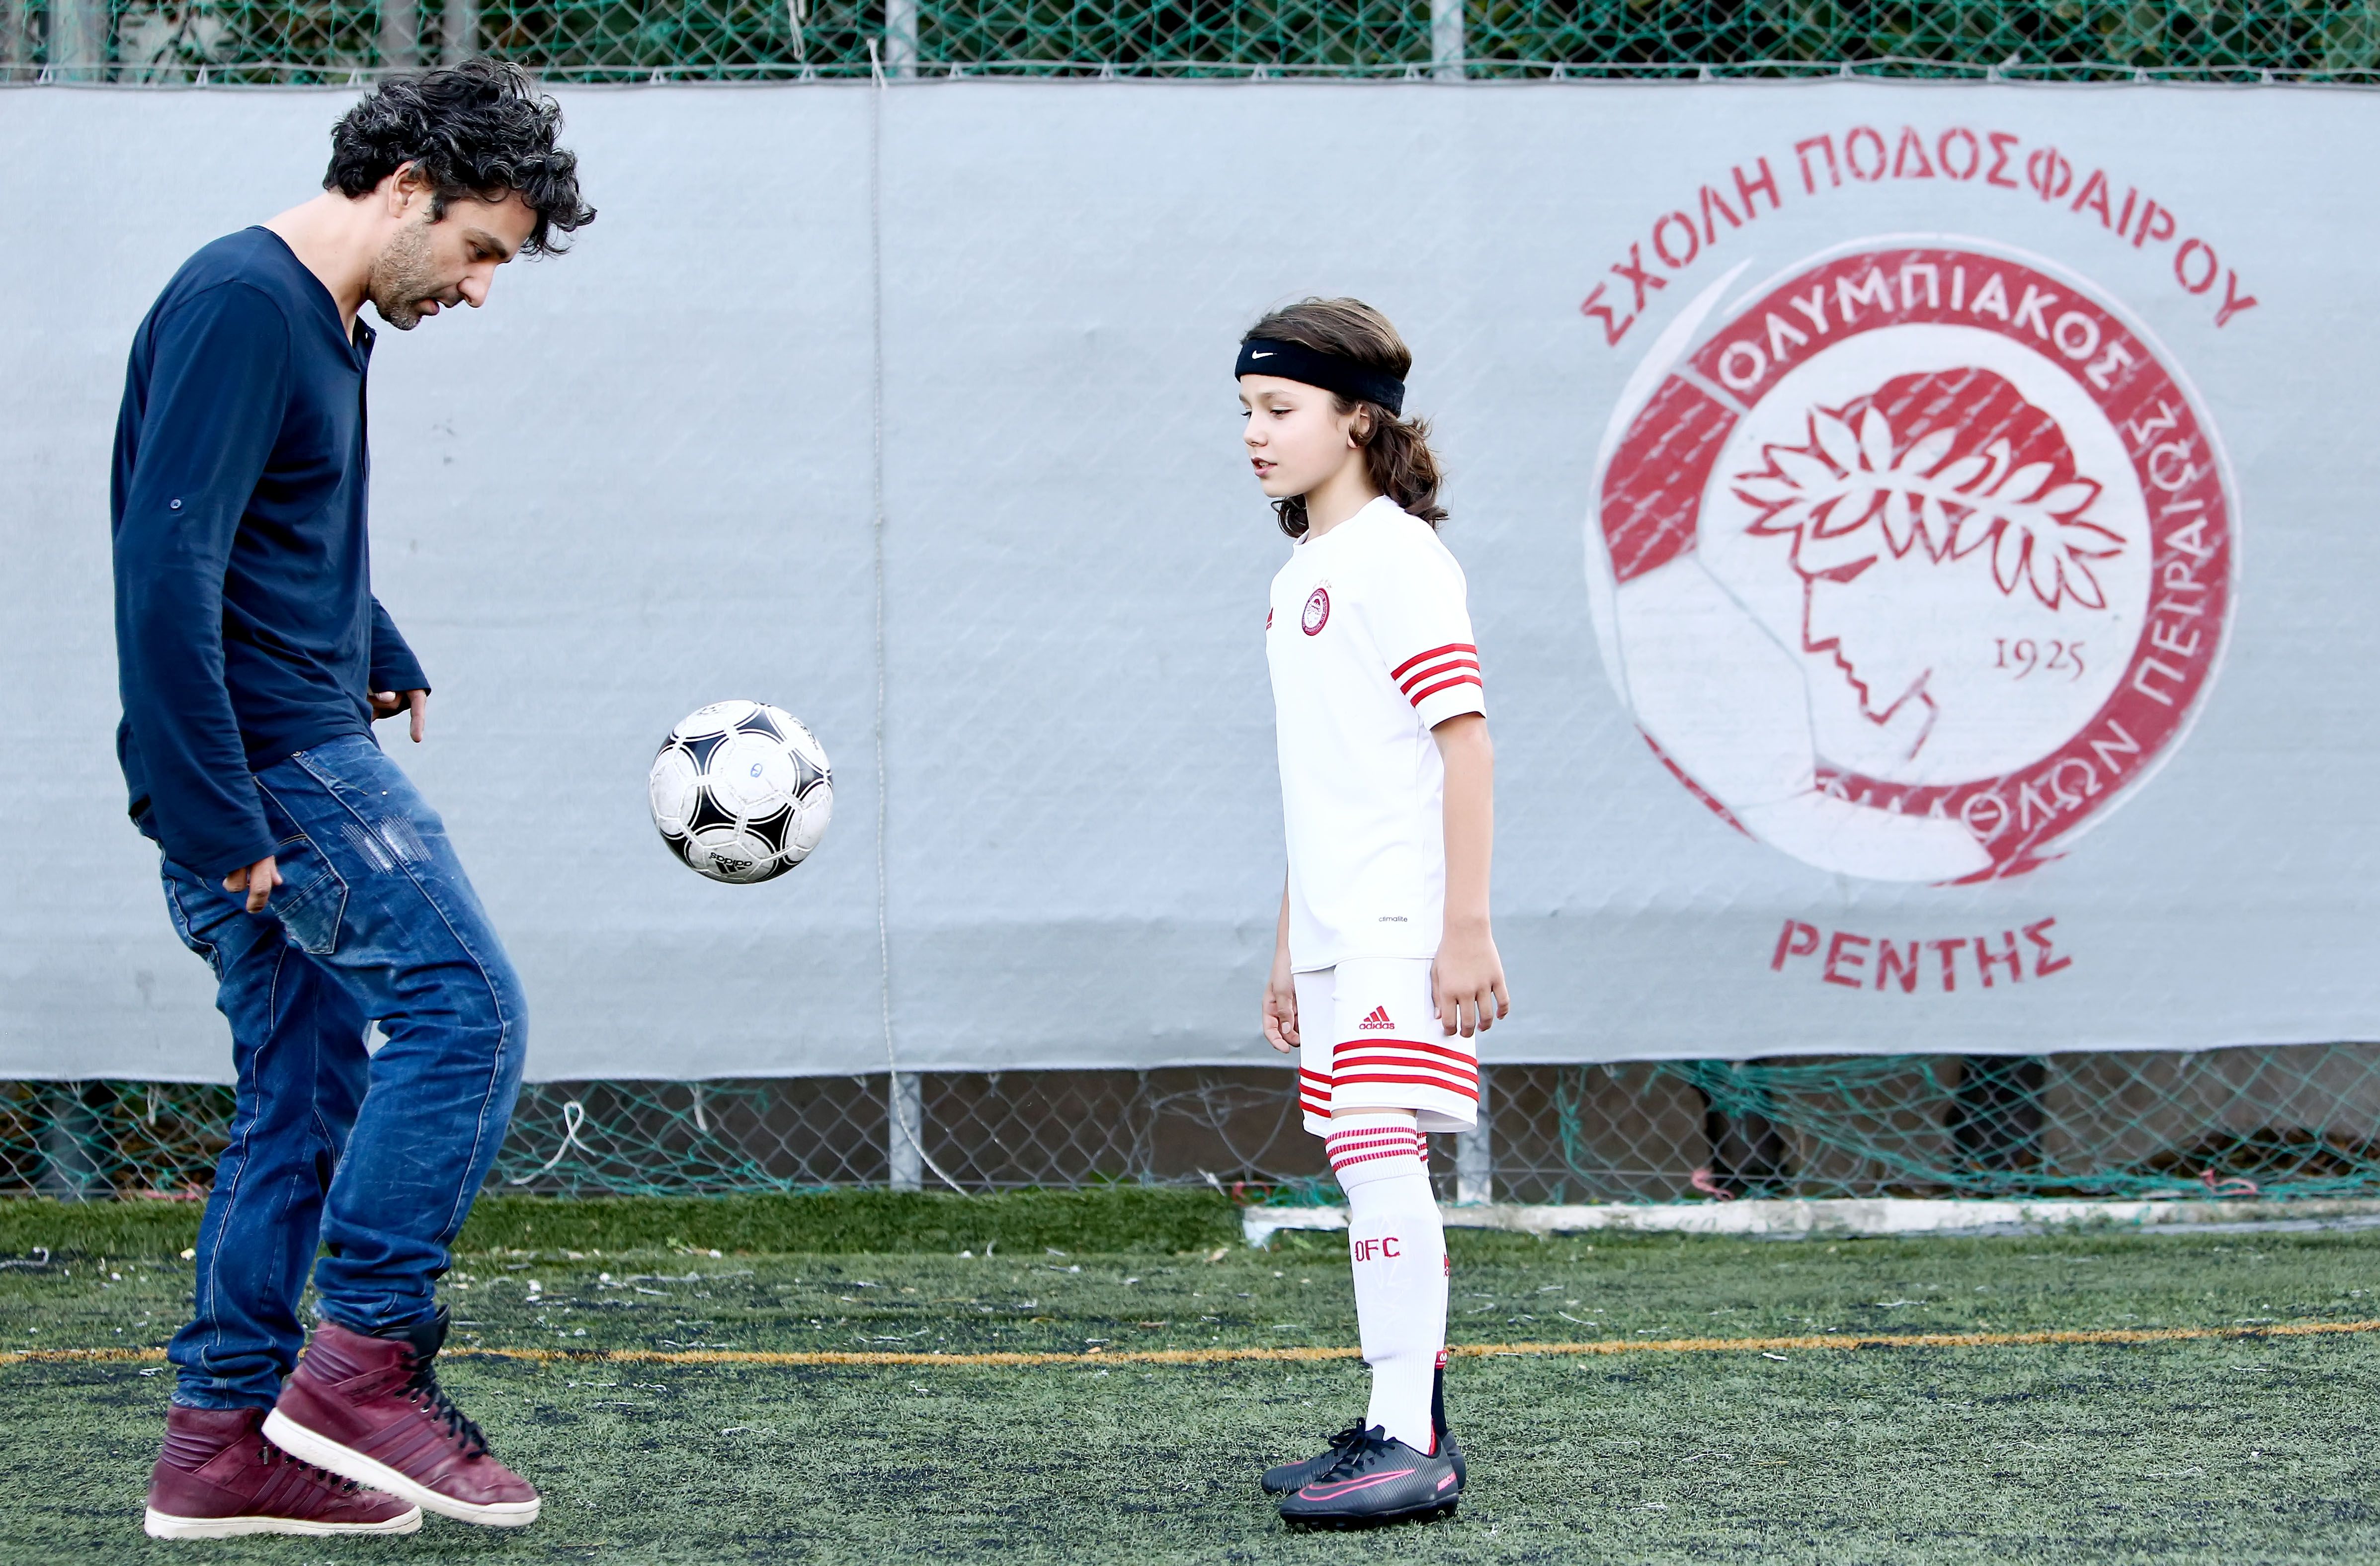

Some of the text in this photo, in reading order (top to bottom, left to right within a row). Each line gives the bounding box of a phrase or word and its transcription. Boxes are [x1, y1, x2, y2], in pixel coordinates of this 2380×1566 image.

[1580, 125, 2258, 347] ΣΧΟΛΗ ΠΟΔΟΣΦΑΙΡΟΥ
[1718, 263, 2135, 391] ΟΛΥΜΠΙΑΚΟΣ
[2129, 400, 2214, 706] ΠΕΙΡΑΙΩΣ
[1994, 638, 2084, 682] 1925
[709, 852, 752, 867] adidas
[1771, 916, 2072, 993] ΡΕΝΤΗΣ
[1355, 1236, 1401, 1262] OFC
